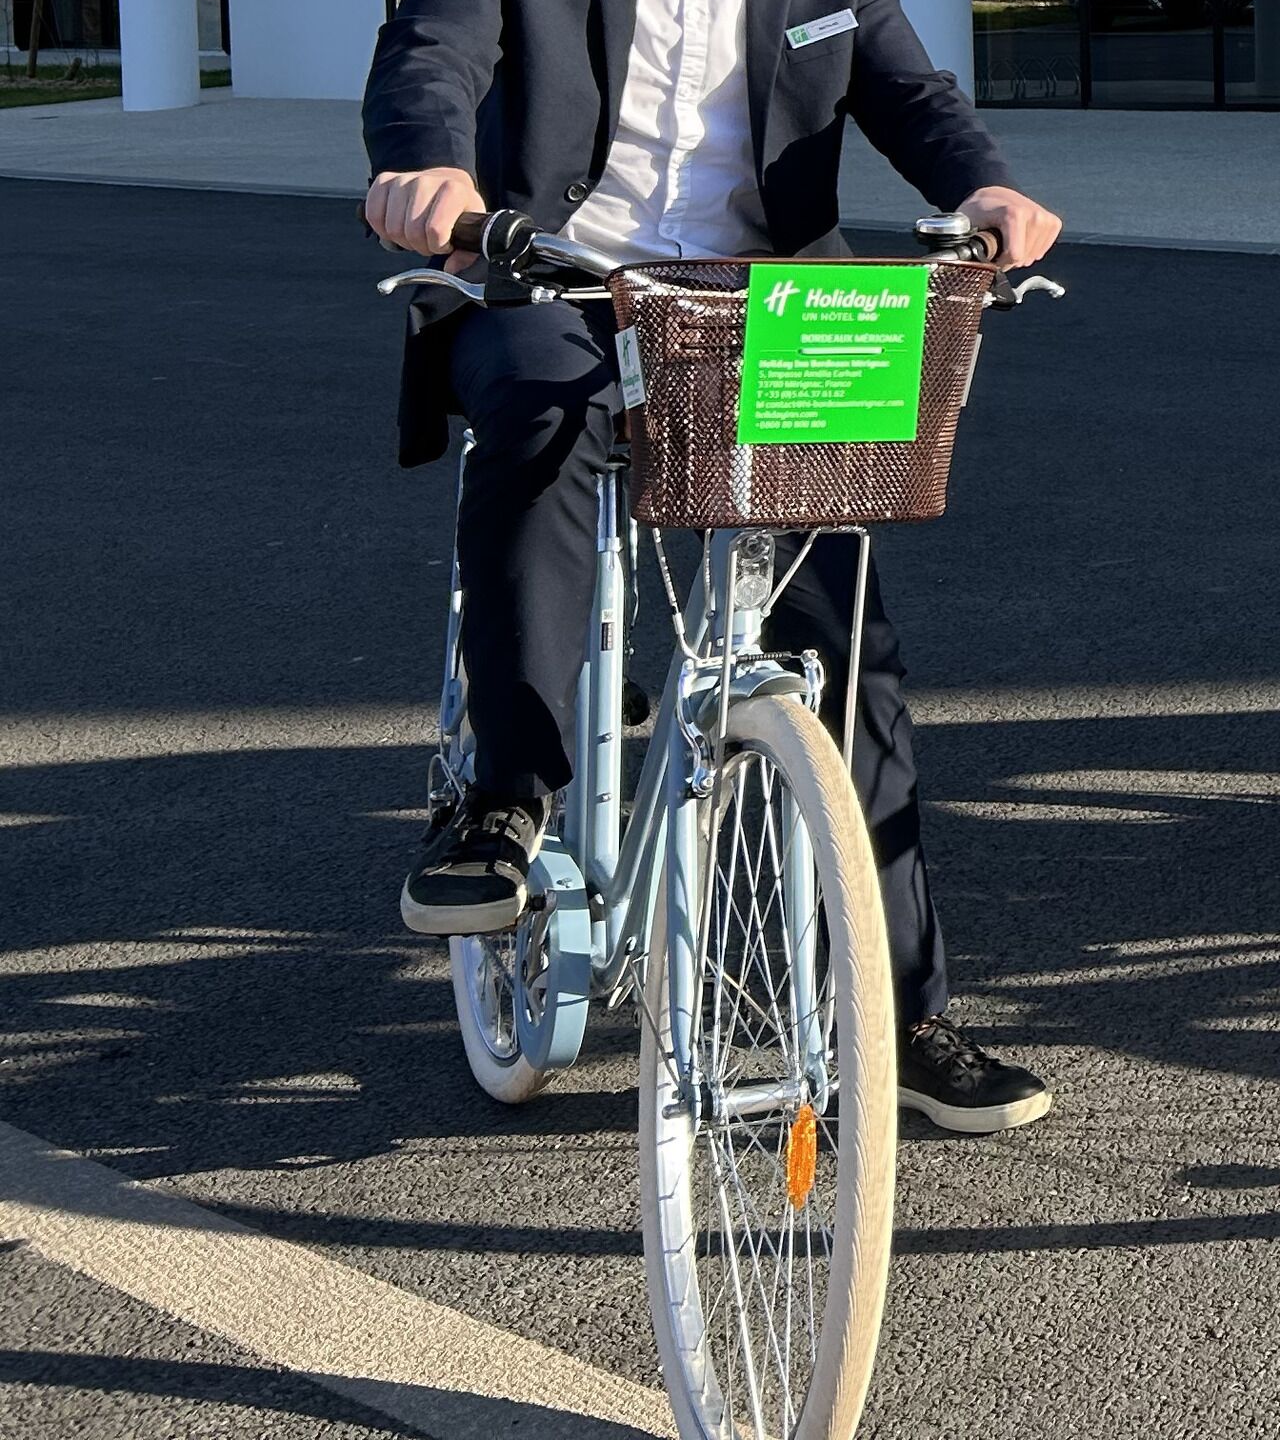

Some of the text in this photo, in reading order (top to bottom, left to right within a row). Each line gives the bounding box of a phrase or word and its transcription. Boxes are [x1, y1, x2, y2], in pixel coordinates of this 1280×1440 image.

[805, 288, 911, 312] Holiday Inn
[801, 312, 818, 322] UN
